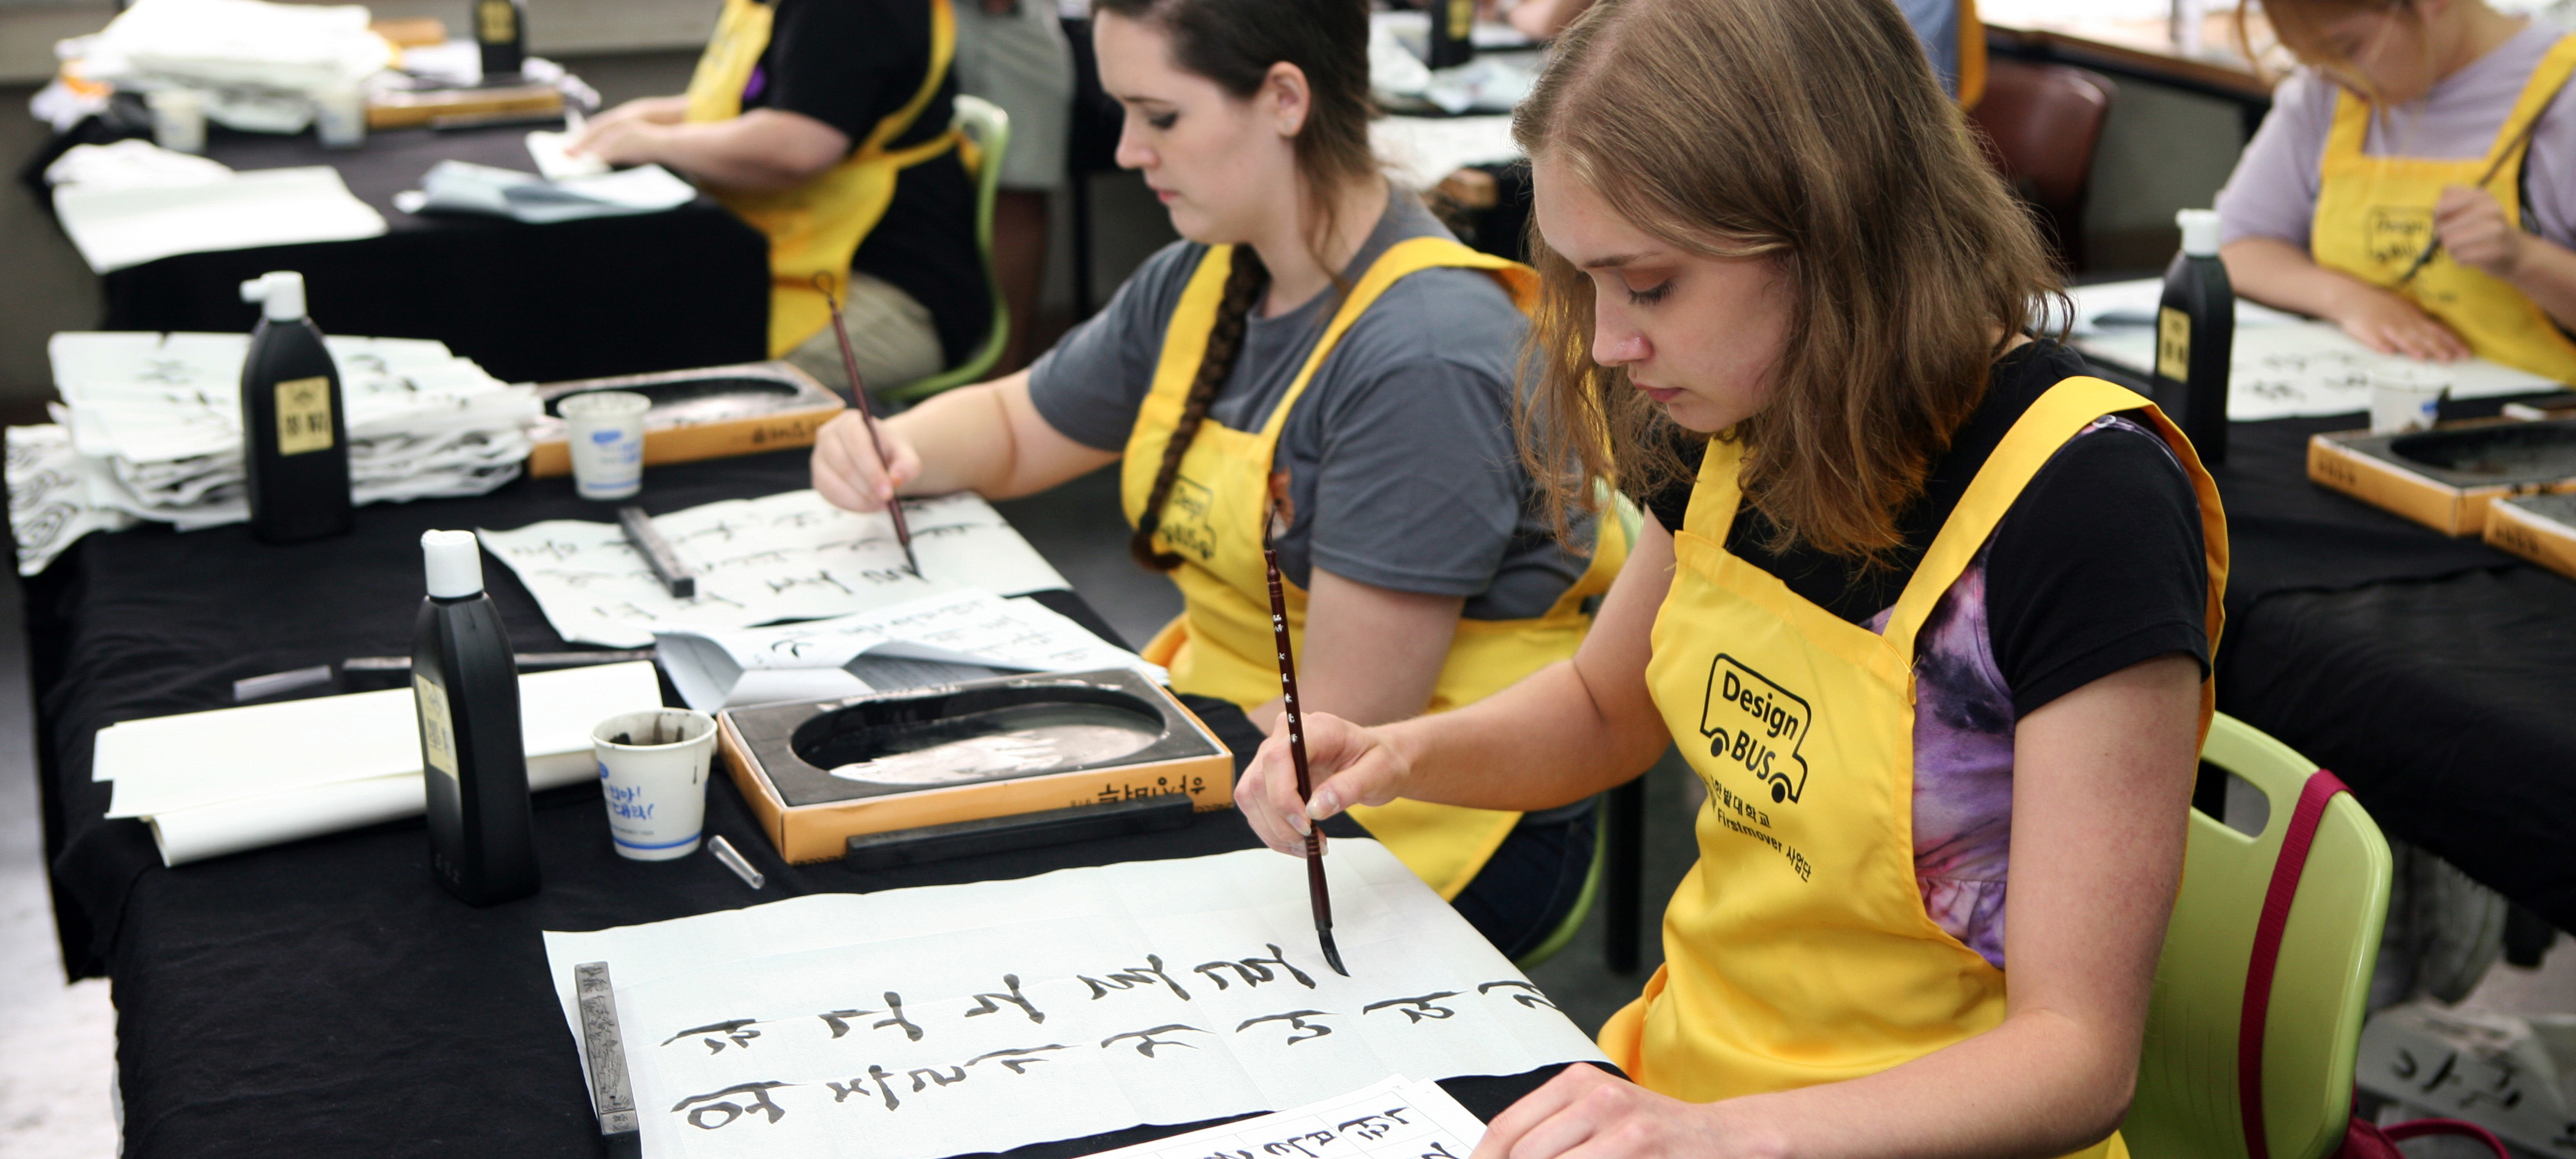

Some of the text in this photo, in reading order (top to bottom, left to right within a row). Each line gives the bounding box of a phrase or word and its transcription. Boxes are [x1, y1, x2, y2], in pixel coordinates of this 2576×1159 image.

[1722, 670, 1799, 740] Design
[1730, 729, 1776, 781] BUS
[1717, 807, 1812, 883] Firstmover 사업단
